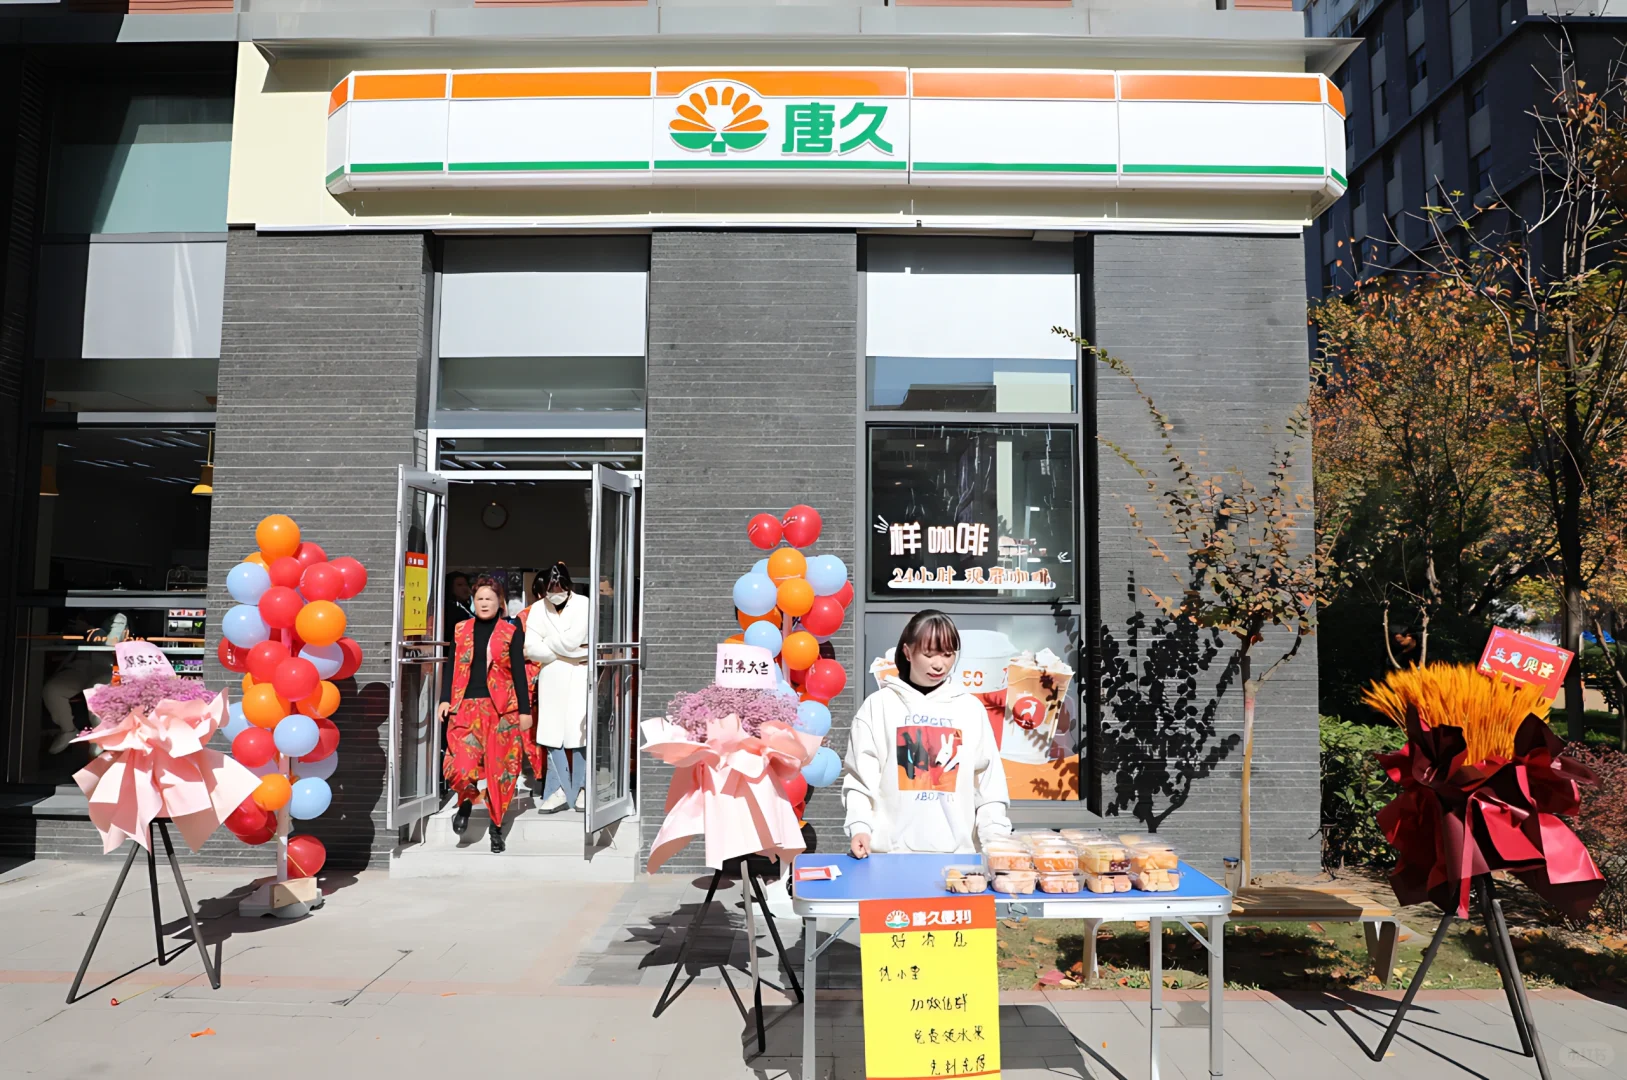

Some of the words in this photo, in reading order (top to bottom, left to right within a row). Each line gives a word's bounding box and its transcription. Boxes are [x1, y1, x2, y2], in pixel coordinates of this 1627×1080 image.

[781, 101, 894, 154] 唐久
[912, 909, 972, 927] 唐久便利
